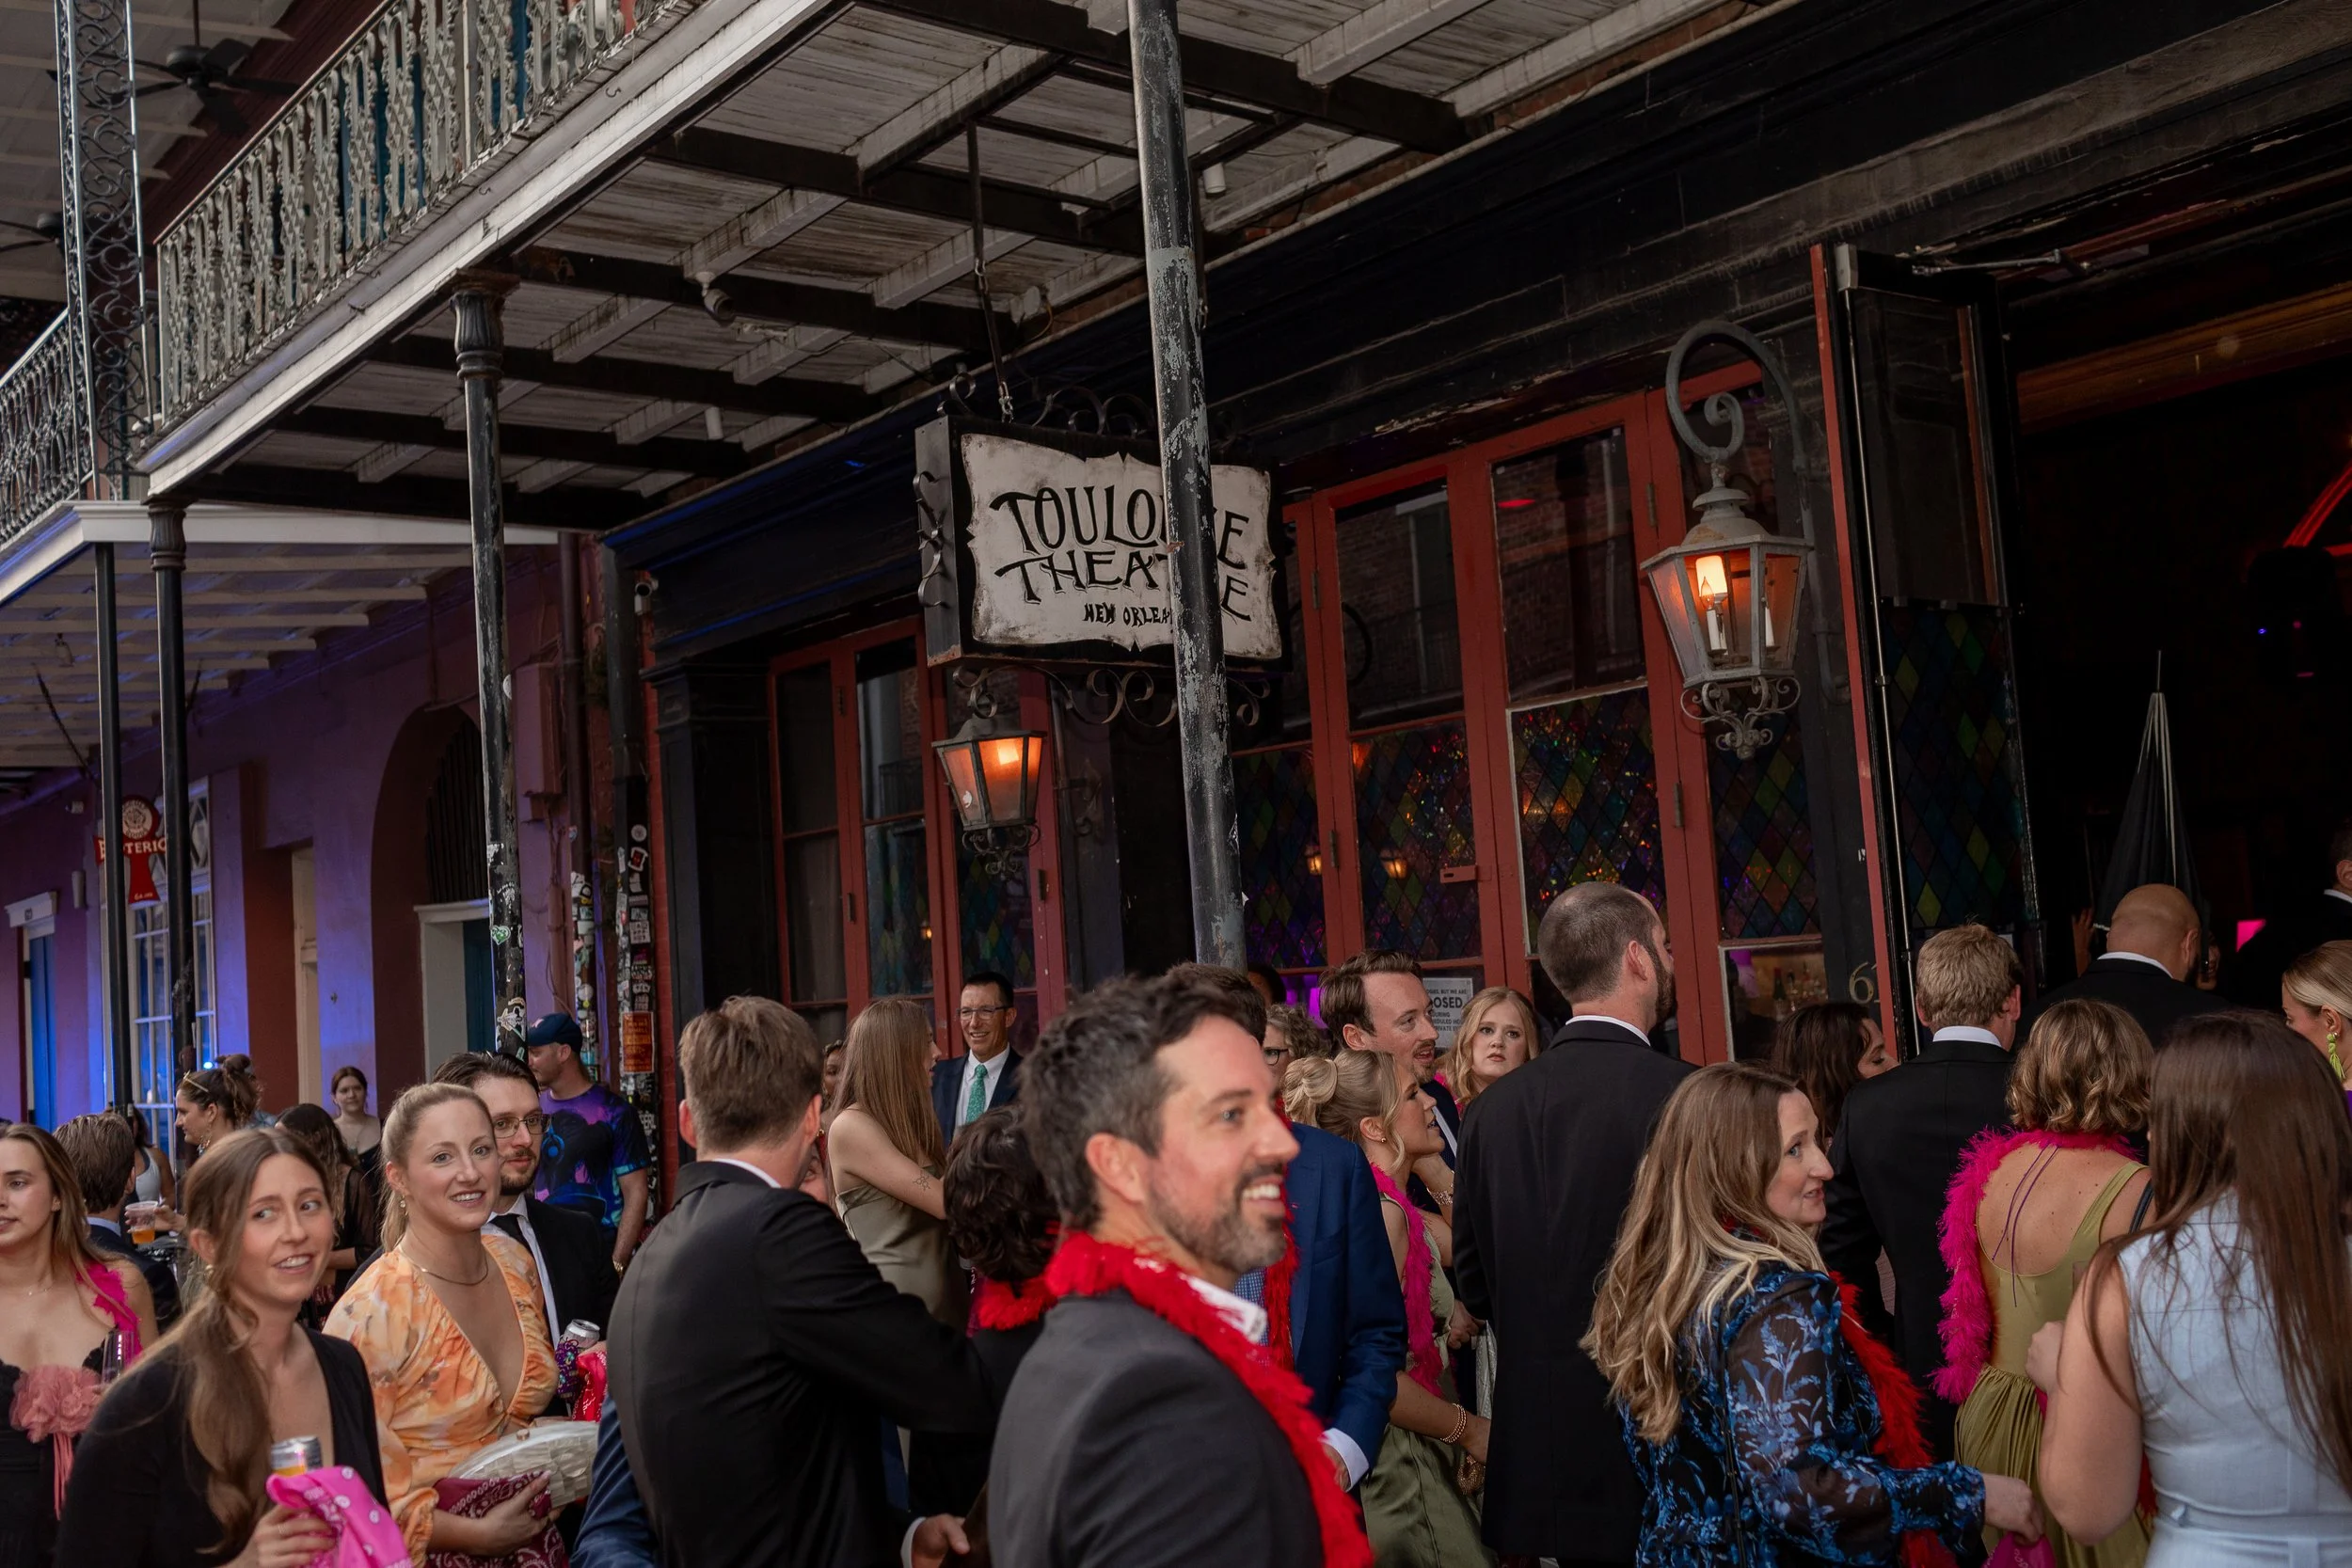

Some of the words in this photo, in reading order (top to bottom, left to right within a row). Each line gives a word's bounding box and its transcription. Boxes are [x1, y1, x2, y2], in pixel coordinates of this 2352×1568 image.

[989, 484, 1249, 569] TOULOE
[993, 549, 1250, 622] THEAE
[1083, 602, 1116, 625] NEW
[1122, 605, 1174, 627] ORLEA
[1433, 997, 1462, 1008] OSED
